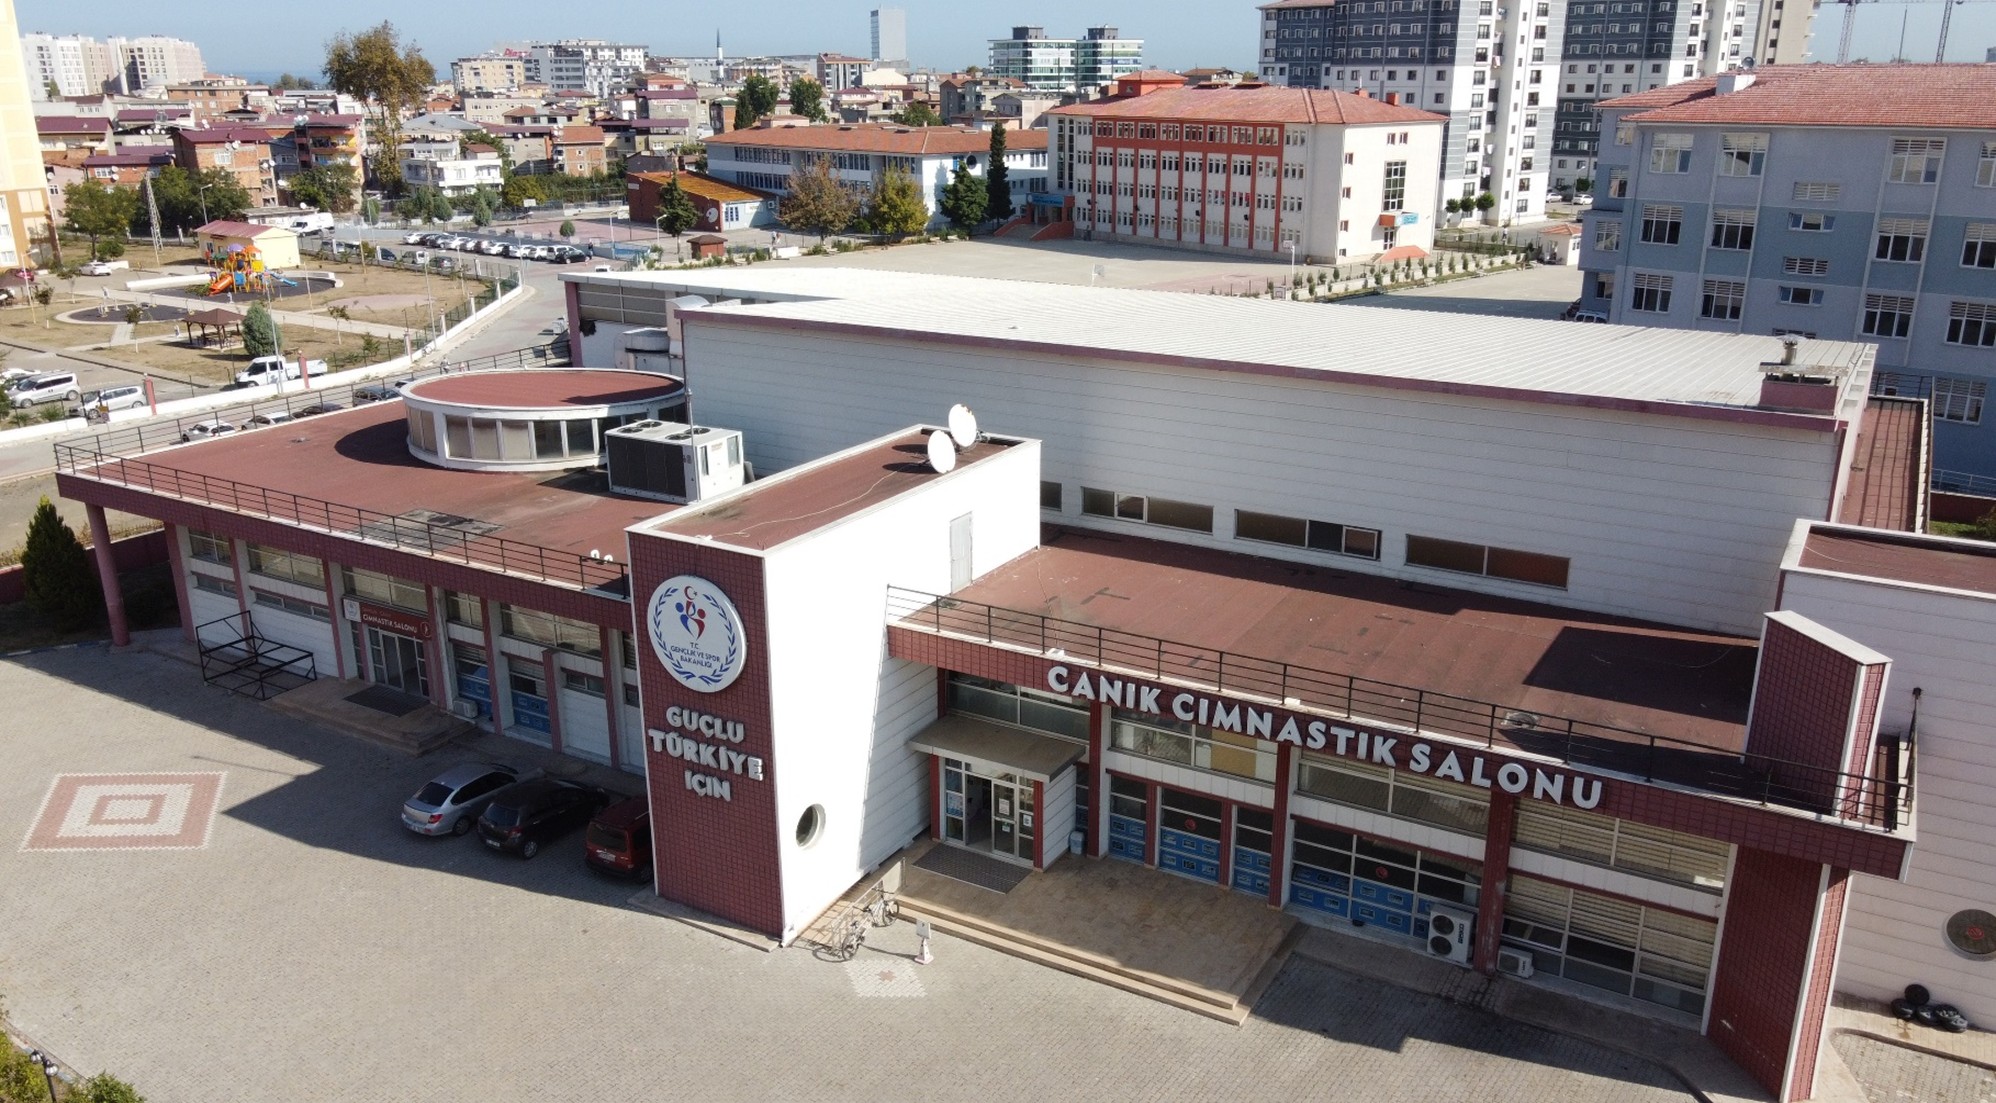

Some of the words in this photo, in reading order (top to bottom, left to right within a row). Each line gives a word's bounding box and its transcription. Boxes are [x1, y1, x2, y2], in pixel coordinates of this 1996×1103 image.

[696, 651, 704, 659] VE
[705, 653, 720, 662] SPOR
[1409, 743, 1602, 810] SALONU
